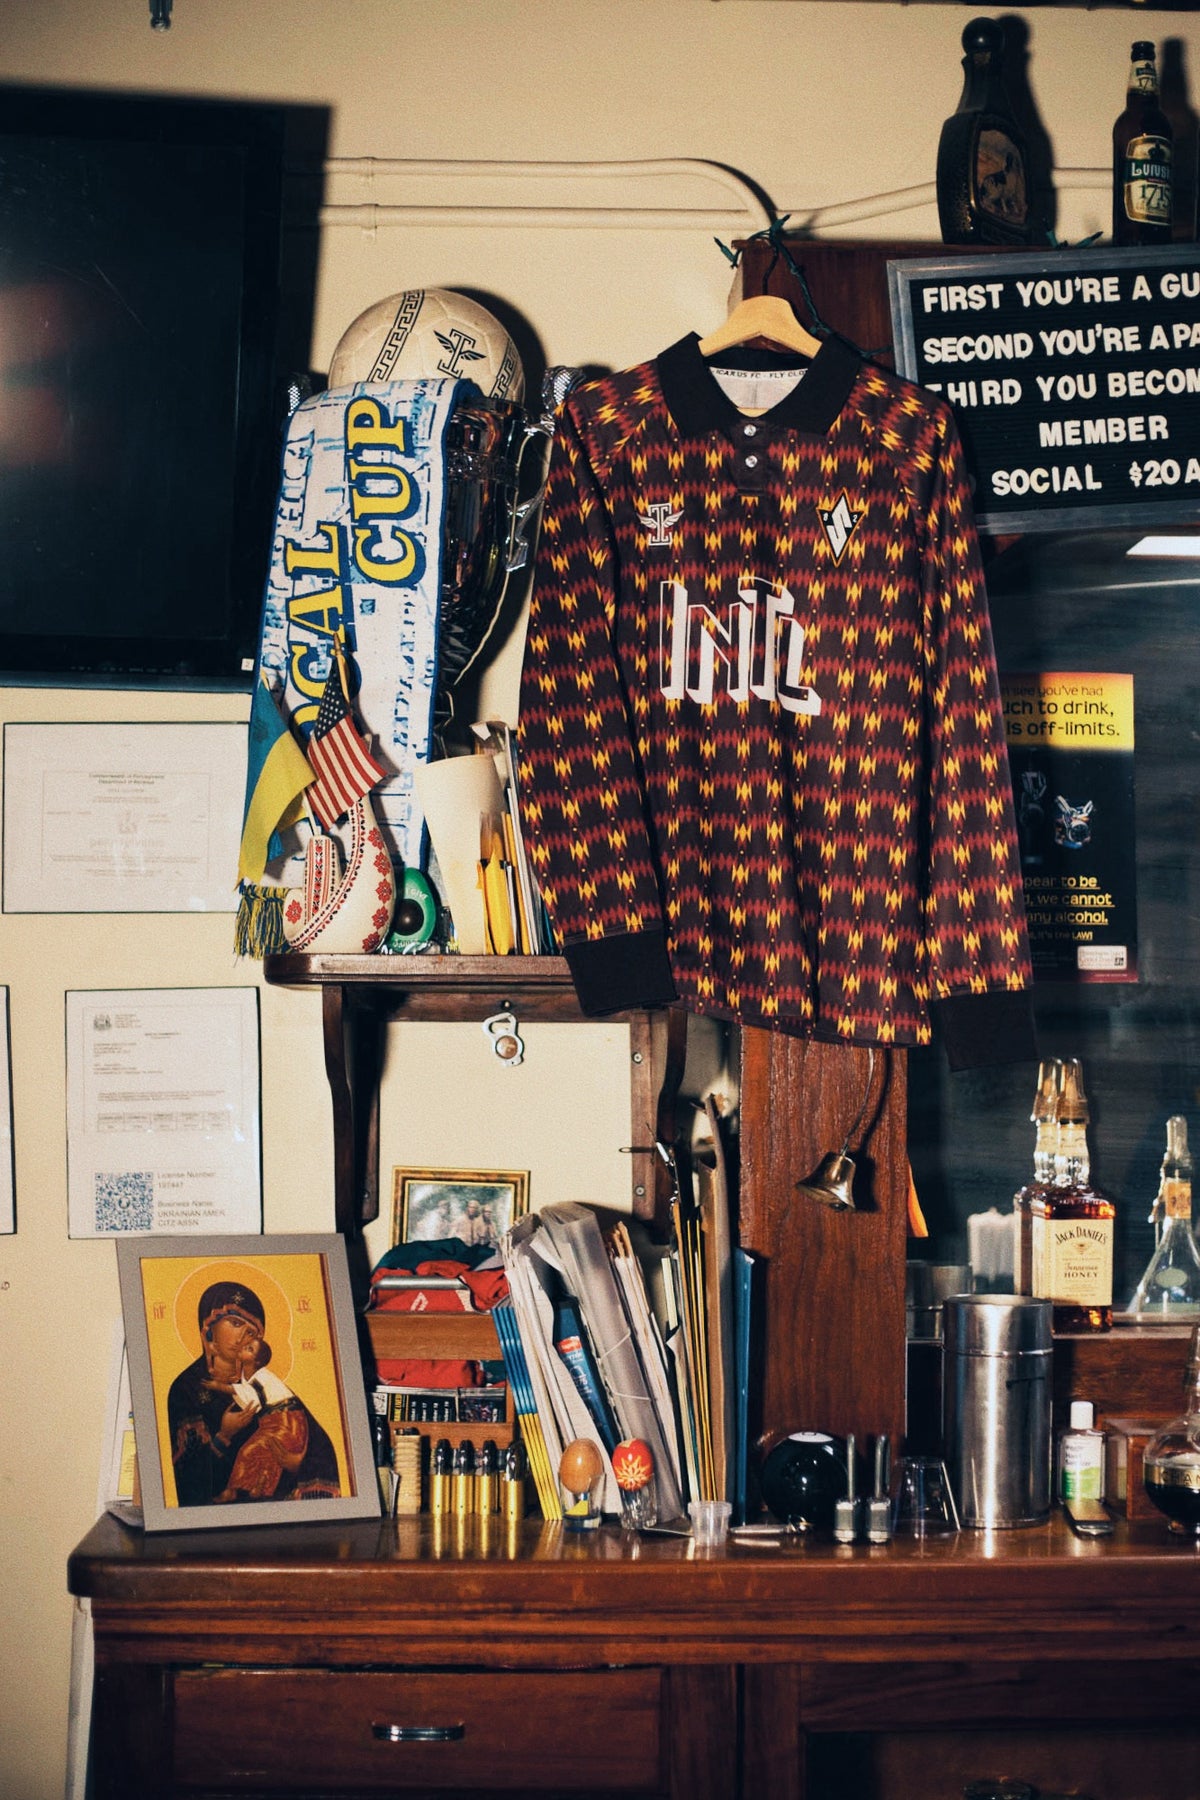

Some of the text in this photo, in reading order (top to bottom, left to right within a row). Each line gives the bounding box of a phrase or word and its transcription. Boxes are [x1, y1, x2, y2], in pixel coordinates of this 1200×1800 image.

[922, 271, 1200, 313] FIRST YOU'RE A GU
[922, 332, 1034, 364] SECOND
[1039, 323, 1142, 357] YOU'RE
[1149, 324, 1170, 350] A
[1036, 373, 1097, 403] YOU
[1038, 415, 1169, 448] MEMBER
[991, 463, 1102, 496] SOCIAL
[1129, 458, 1181, 488] $20
[346, 397, 421, 585] CUP
[285, 520, 348, 743] CAL
[1039, 685, 1079, 698] you've
[1081, 685, 1104, 696] had
[1038, 701, 1058, 715] to
[1063, 701, 1114, 718] drink,
[1027, 721, 1120, 736] off-limits.
[1061, 876, 1077, 887] to
[1079, 875, 1098, 888] be
[1062, 893, 1113, 905] cannot
[1055, 910, 1108, 923] alcohol.
[1054, 1228, 1075, 1246] JACK
